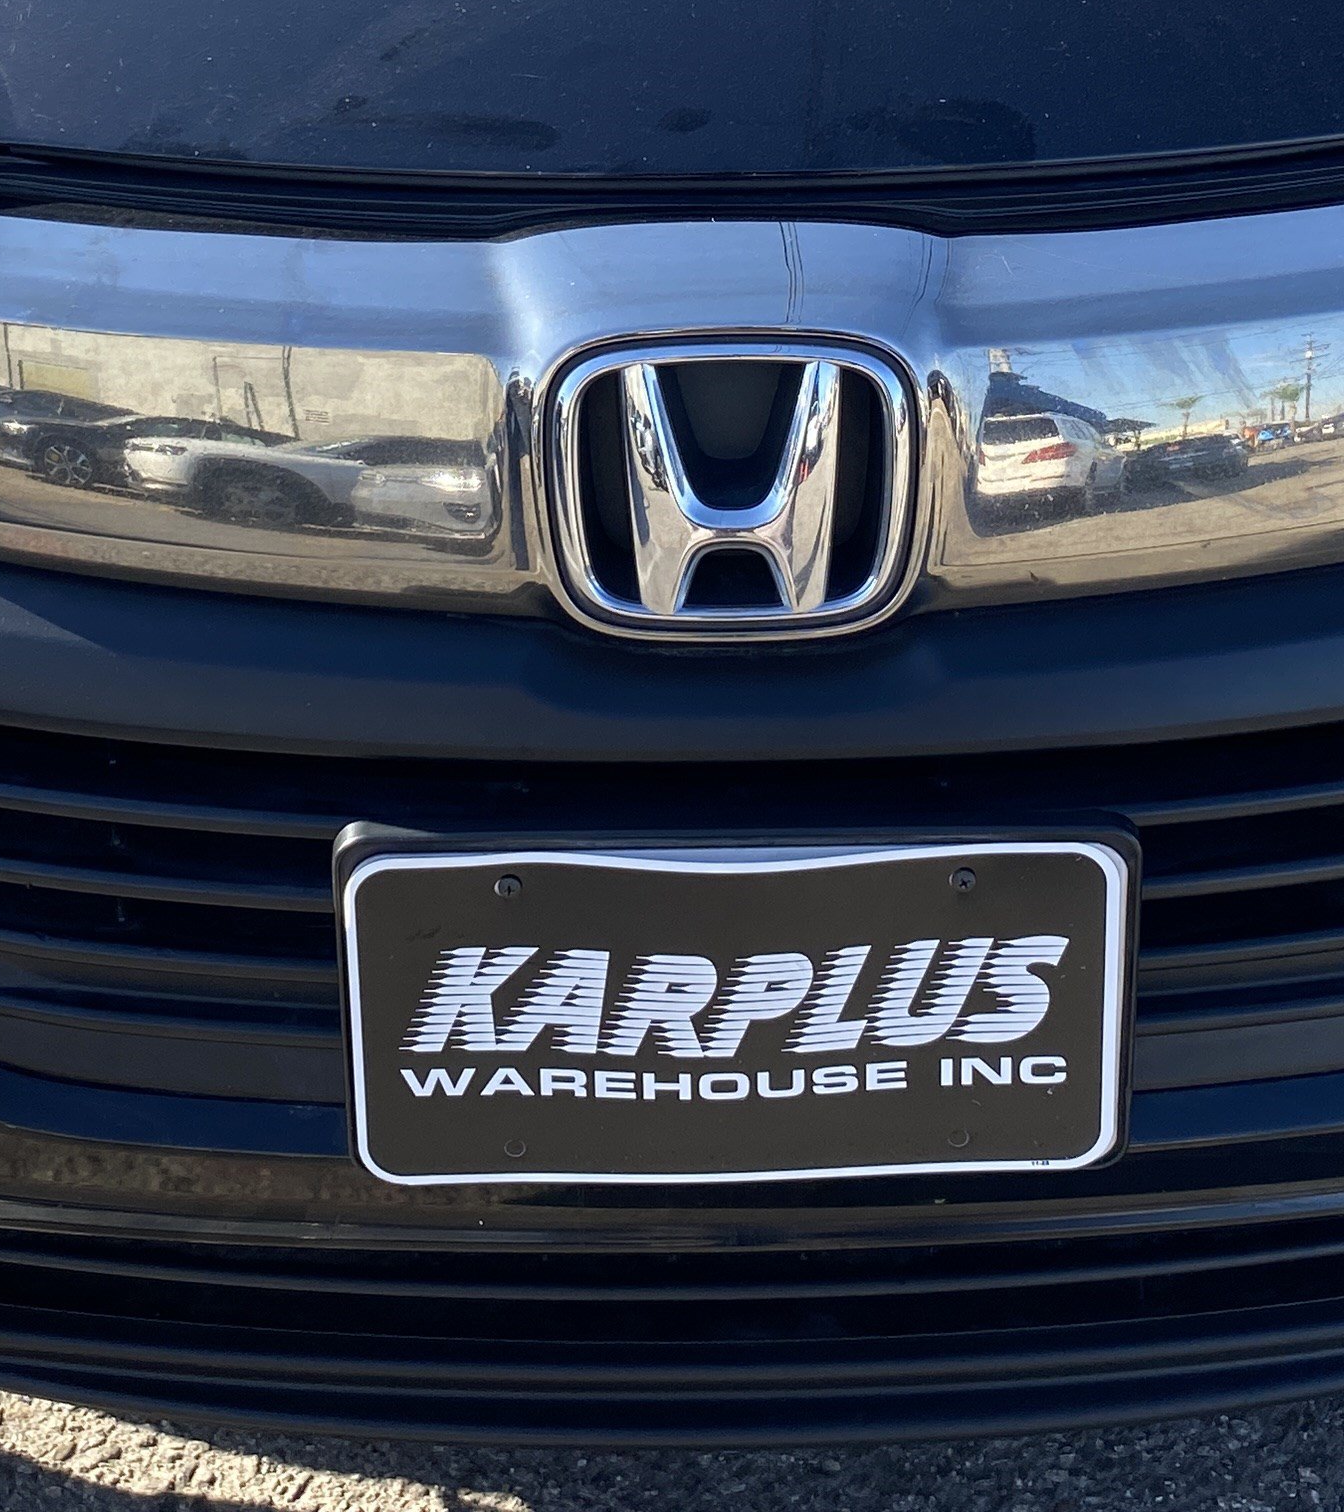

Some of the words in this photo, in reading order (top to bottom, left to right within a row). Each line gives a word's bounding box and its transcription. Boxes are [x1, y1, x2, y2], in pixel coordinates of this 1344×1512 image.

[397, 934, 1071, 1057] KARPLUS
[399, 1059, 909, 1102] WAREHOUSE
[937, 1054, 1069, 1087] INC
